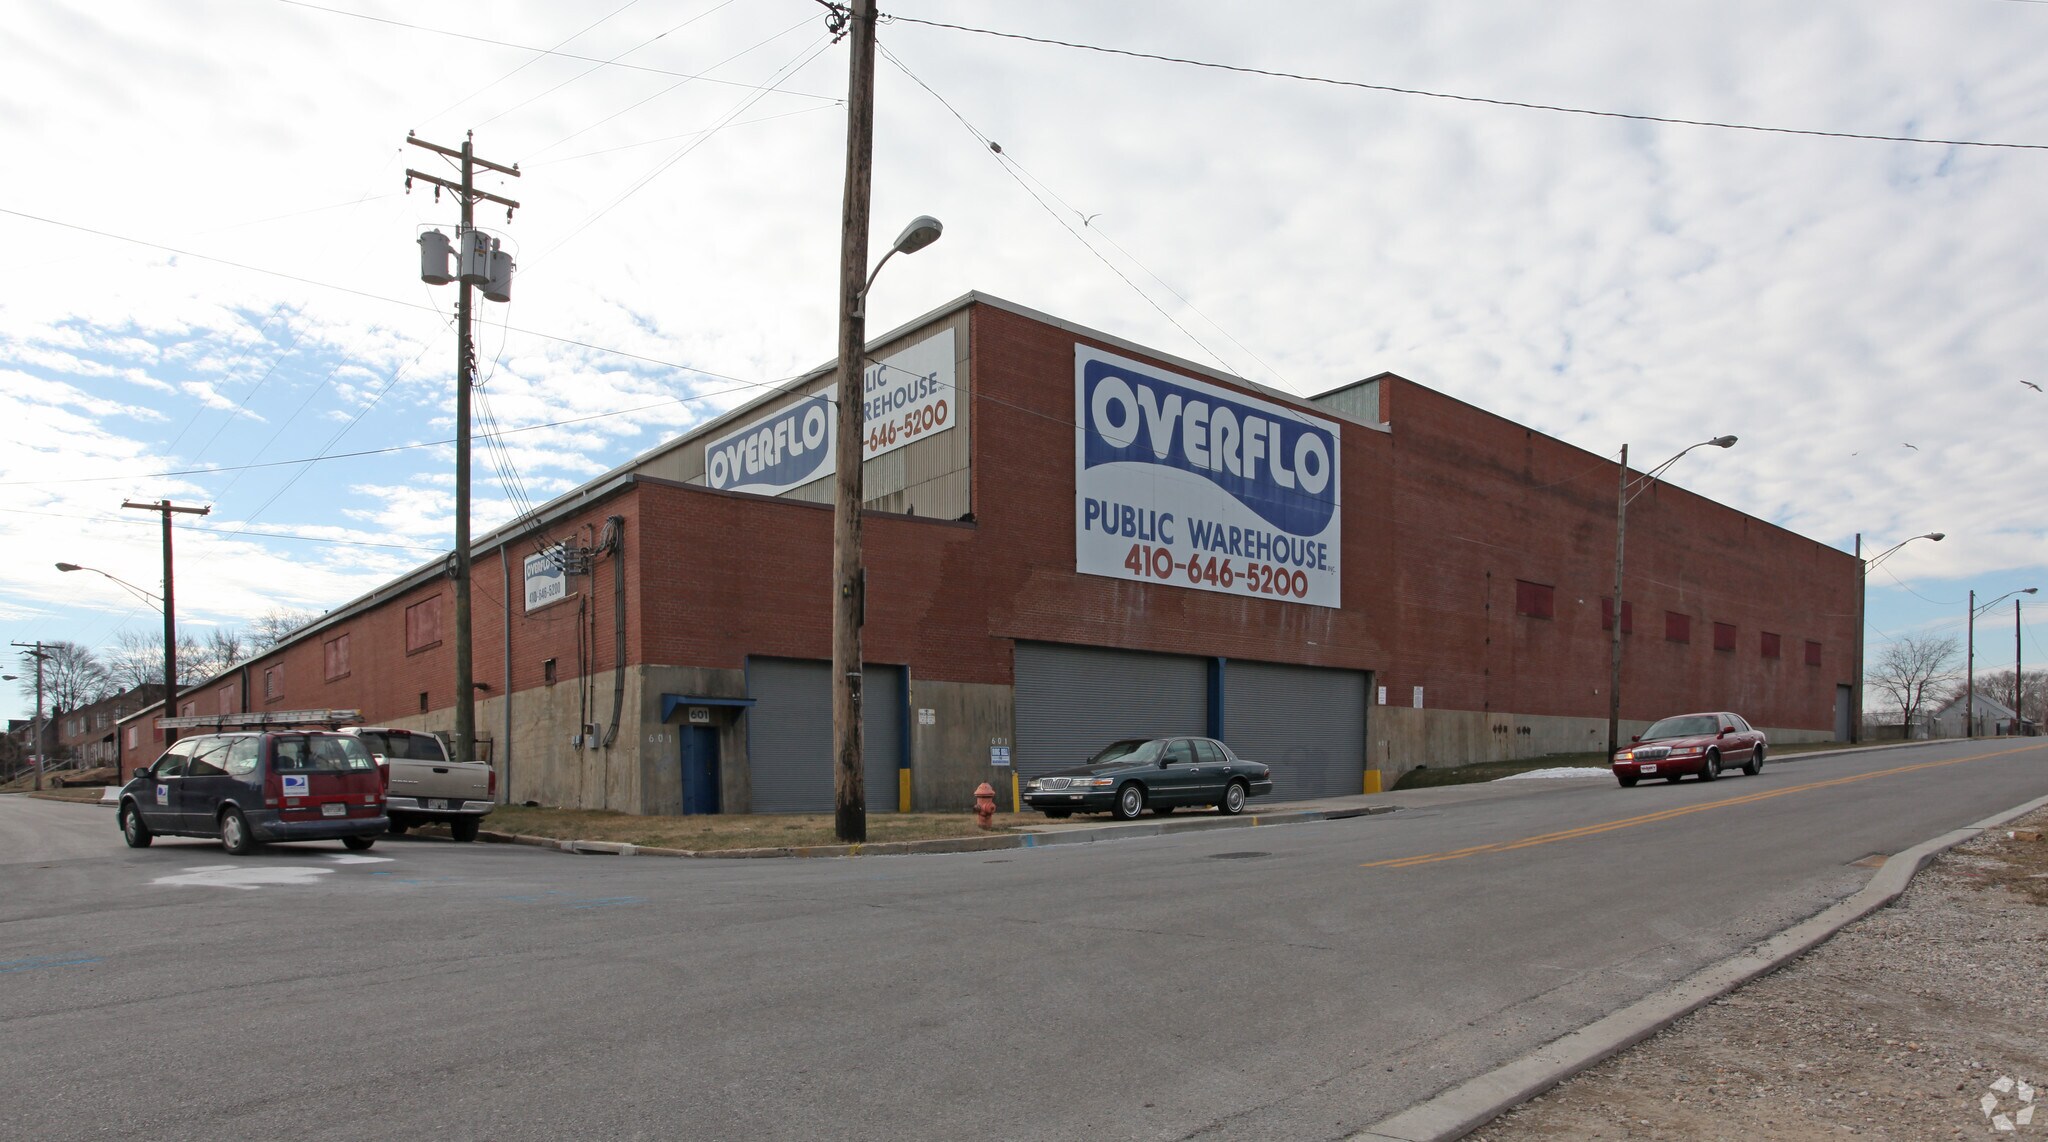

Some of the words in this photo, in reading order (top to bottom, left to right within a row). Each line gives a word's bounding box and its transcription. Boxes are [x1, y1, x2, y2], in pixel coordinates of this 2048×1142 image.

[864, 371, 937, 424] REHOUSE
[709, 405, 826, 490] OVERFLO
[864, 399, 948, 452] -646-5200
[1091, 376, 1330, 495] OVERFLO
[1084, 497, 1174, 545] PUBLIC
[1187, 517, 1328, 571] WAREHOUSE
[1124, 543, 1308, 599] 410-646-5200
[648, 734, 672, 743] 601
[690, 710, 708, 720] 601
[991, 737, 1008, 745] 601
